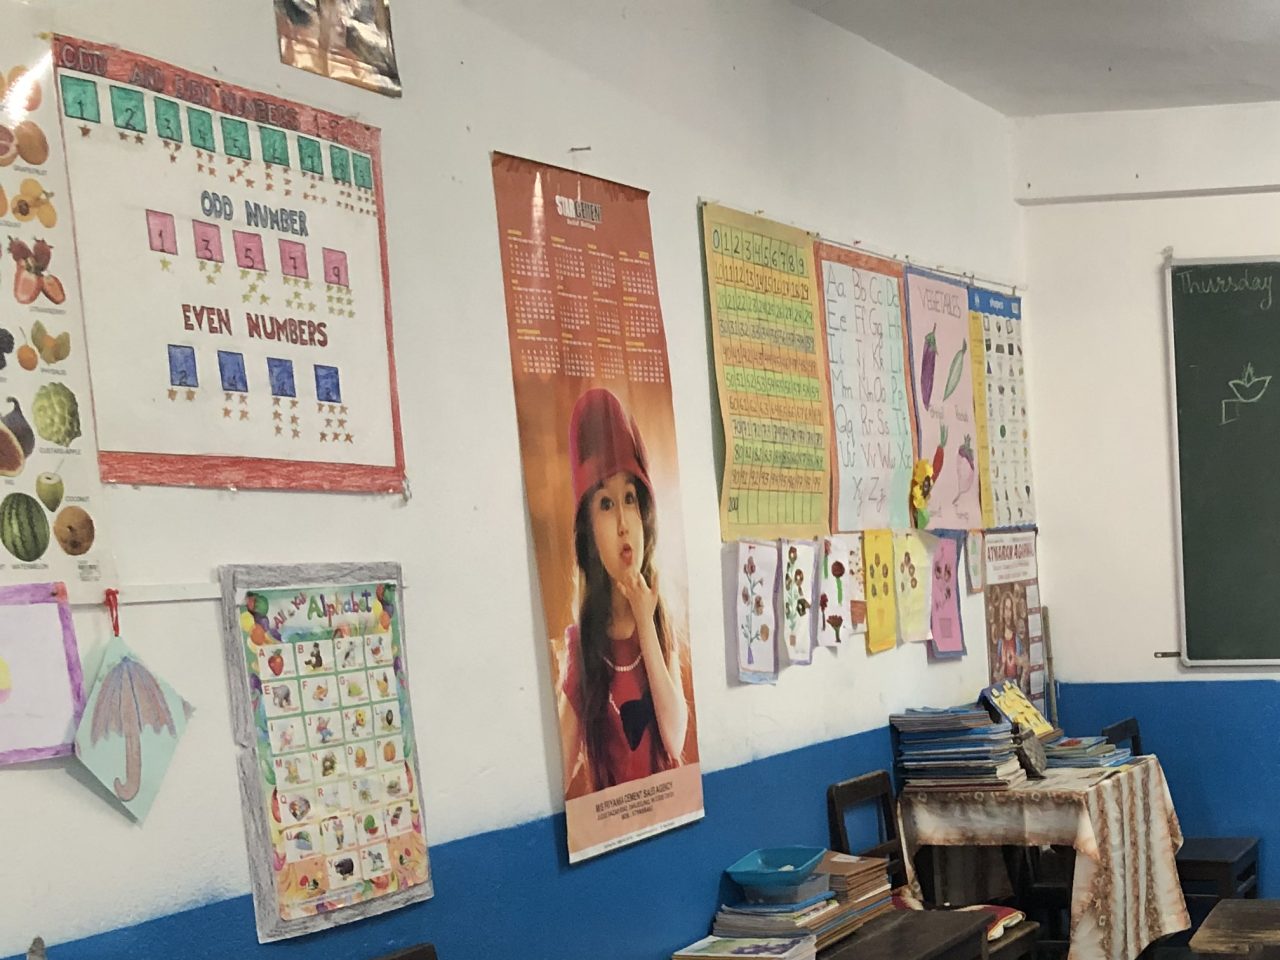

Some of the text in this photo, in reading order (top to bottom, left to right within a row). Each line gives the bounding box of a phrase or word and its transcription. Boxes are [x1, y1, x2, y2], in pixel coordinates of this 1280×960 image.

[77, 99, 87, 120] 1
[124, 107, 138, 130] 2
[163, 117, 175, 140] 3
[201, 190, 309, 237] ODD NUMBER
[158, 229, 342, 286] 1 3 5 7 9
[712, 229, 805, 275] 0 1 2 3 4 5 6 7 8 9
[735, 265, 746, 285] 12
[745, 268, 755, 288] 13
[801, 282, 810, 301] 19
[826, 263, 847, 298] Aa
[852, 268, 867, 302] Bb
[870, 276, 883, 306] Cc
[1175, 268, 1273, 311] Thursday
[181, 303, 328, 348] EVEN NUMBERS
[827, 298, 847, 332] Ee
[179, 369, 188, 386] 2
[831, 368, 854, 400] Mm
[307, 588, 373, 628] Alphabet
[258, 648, 265, 657] A
[298, 644, 304, 653] B
[336, 640, 342, 649] C
[264, 685, 270, 695] E
[302, 680, 307, 690] F
[339, 676, 346, 685] G
[344, 712, 350, 720] K
[275, 758, 283, 768] M
[312, 753, 319, 762] N
[280, 795, 287, 804] Q
[318, 788, 324, 797] R
[286, 832, 293, 841] U
[357, 815, 363, 824] W
